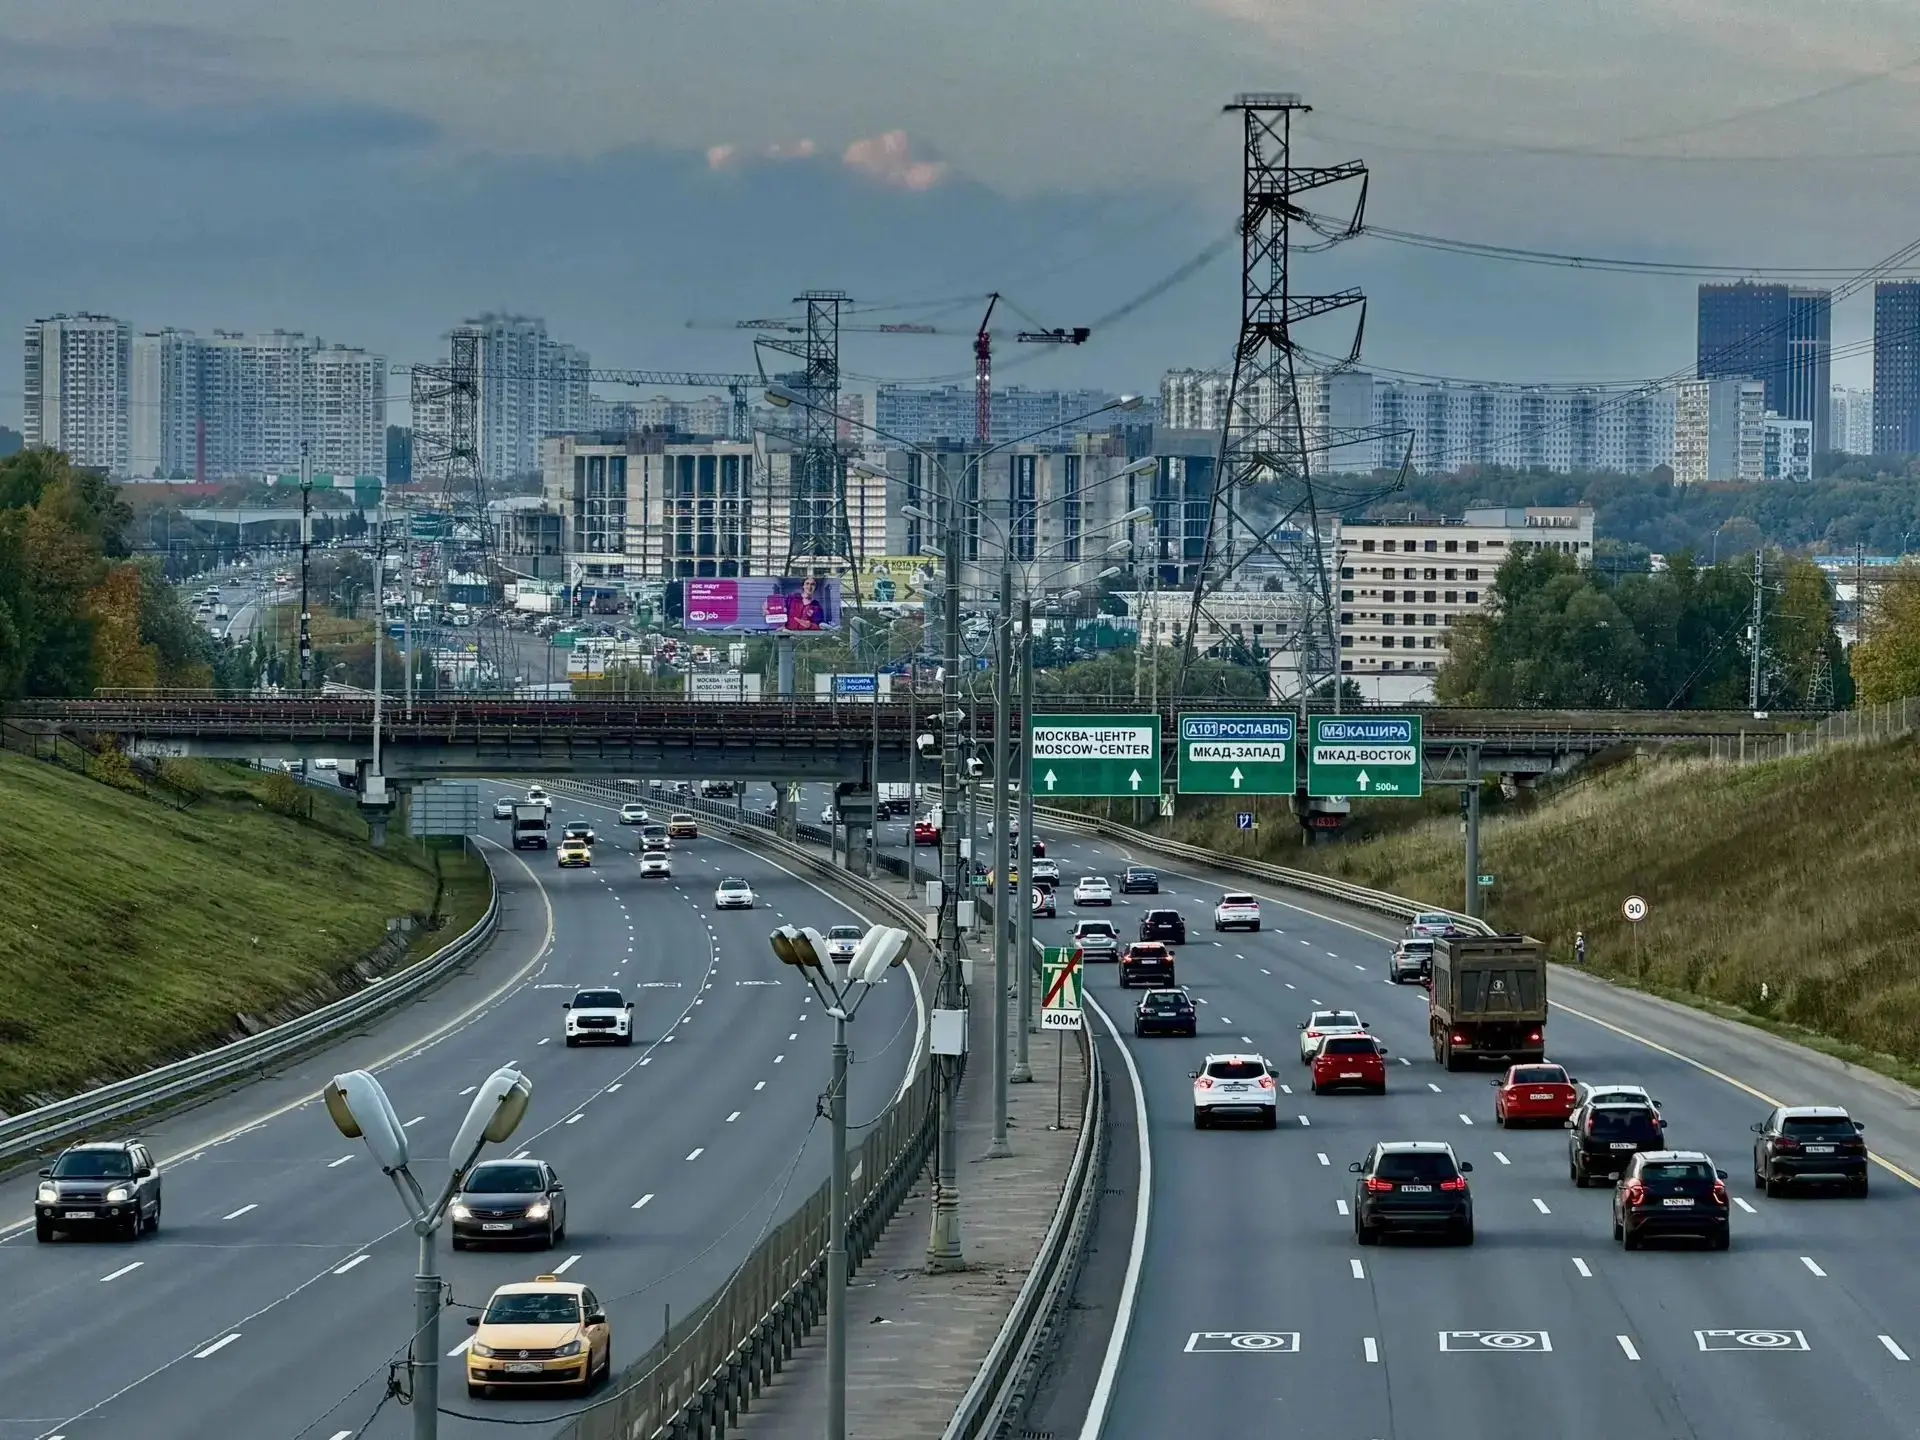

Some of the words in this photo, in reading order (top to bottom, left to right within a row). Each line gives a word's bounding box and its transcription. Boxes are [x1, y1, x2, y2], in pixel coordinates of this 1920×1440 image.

[706, 612, 719, 620] job
[1219, 724, 1288, 734] РОСЛАВЛЬ
[1347, 726, 1407, 736] КАШИРА
[1035, 731, 1137, 743] МОСКВА-ЦЕНТР
[1034, 744, 1150, 755] MOSCOW-CENTER
[1193, 747, 1280, 758] МКАД-ЗАПАД
[1318, 750, 1411, 761] МКАД-ВОСТОК
[1375, 783, 1399, 791] 500м
[1628, 903, 1642, 914] 90
